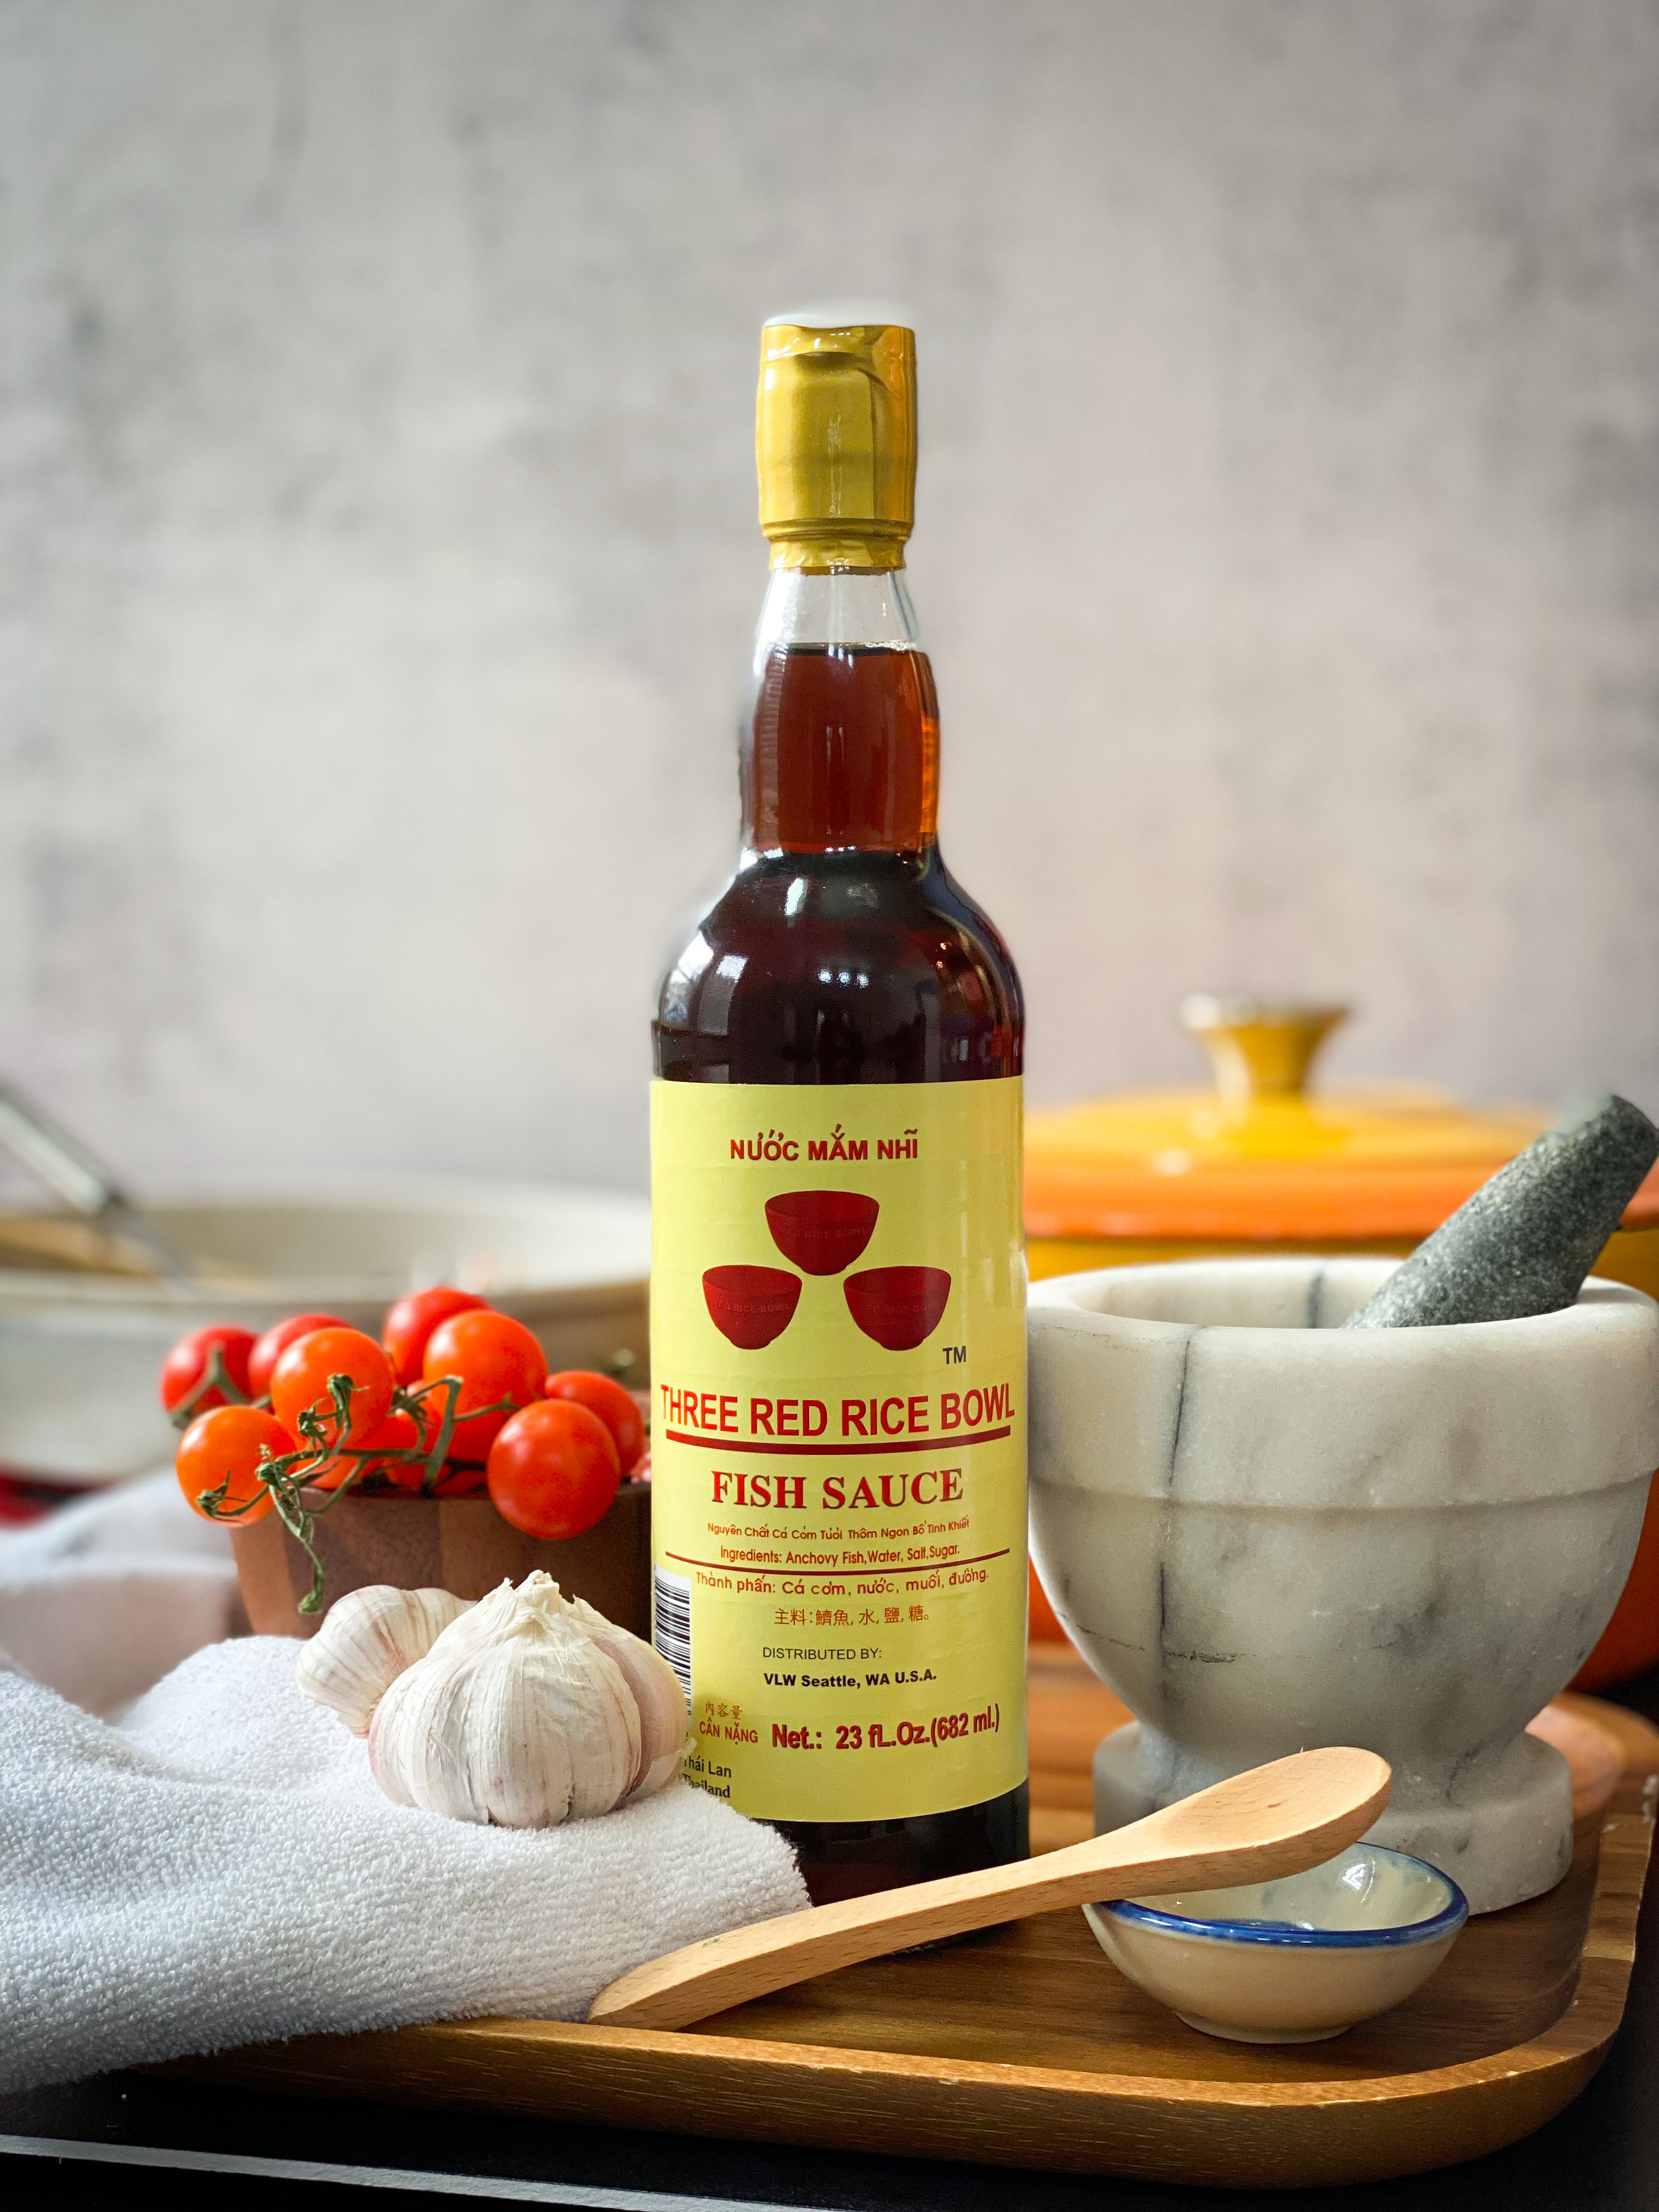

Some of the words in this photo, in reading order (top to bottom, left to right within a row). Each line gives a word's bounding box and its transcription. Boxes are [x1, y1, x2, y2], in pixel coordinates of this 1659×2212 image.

[808, 1124, 867, 1160] MẮM
[877, 1128, 918, 1159] NHĨ
[943, 1346, 966, 1364] TM
[661, 1384, 738, 1432] THREE
[751, 1398, 827, 1436] RED
[842, 1395, 929, 1436] RICE
[941, 1383, 1015, 1430] BOWL
[712, 1470, 807, 1509] FISH
[823, 1468, 963, 1509] SAUCE
[708, 1522, 742, 1536] Nguyên
[744, 1523, 770, 1538] Chất
[772, 1526, 788, 1539] Cá
[881, 1528, 909, 1539] Ngon
[720, 1545, 782, 1562] Ingredients:
[786, 1550, 838, 1567] Anchovy
[696, 1571, 732, 1589] Thành
[782, 1579, 805, 1594] Cá
[763, 1647, 856, 1660] DISTRIBUTED
[860, 1647, 882, 1659] BY:
[764, 1673, 796, 1686] VLW
[801, 1675, 861, 1689] Seattle,
[865, 1673, 890, 1685] WA
[895, 1668, 936, 1684] U.S.A.
[699, 1716, 720, 1737] CÂN
[725, 1722, 758, 1745] NẶNG
[772, 1724, 822, 1750] Net.:
[836, 1725, 862, 1749] 23
[708, 1760, 731, 1778] Lan
